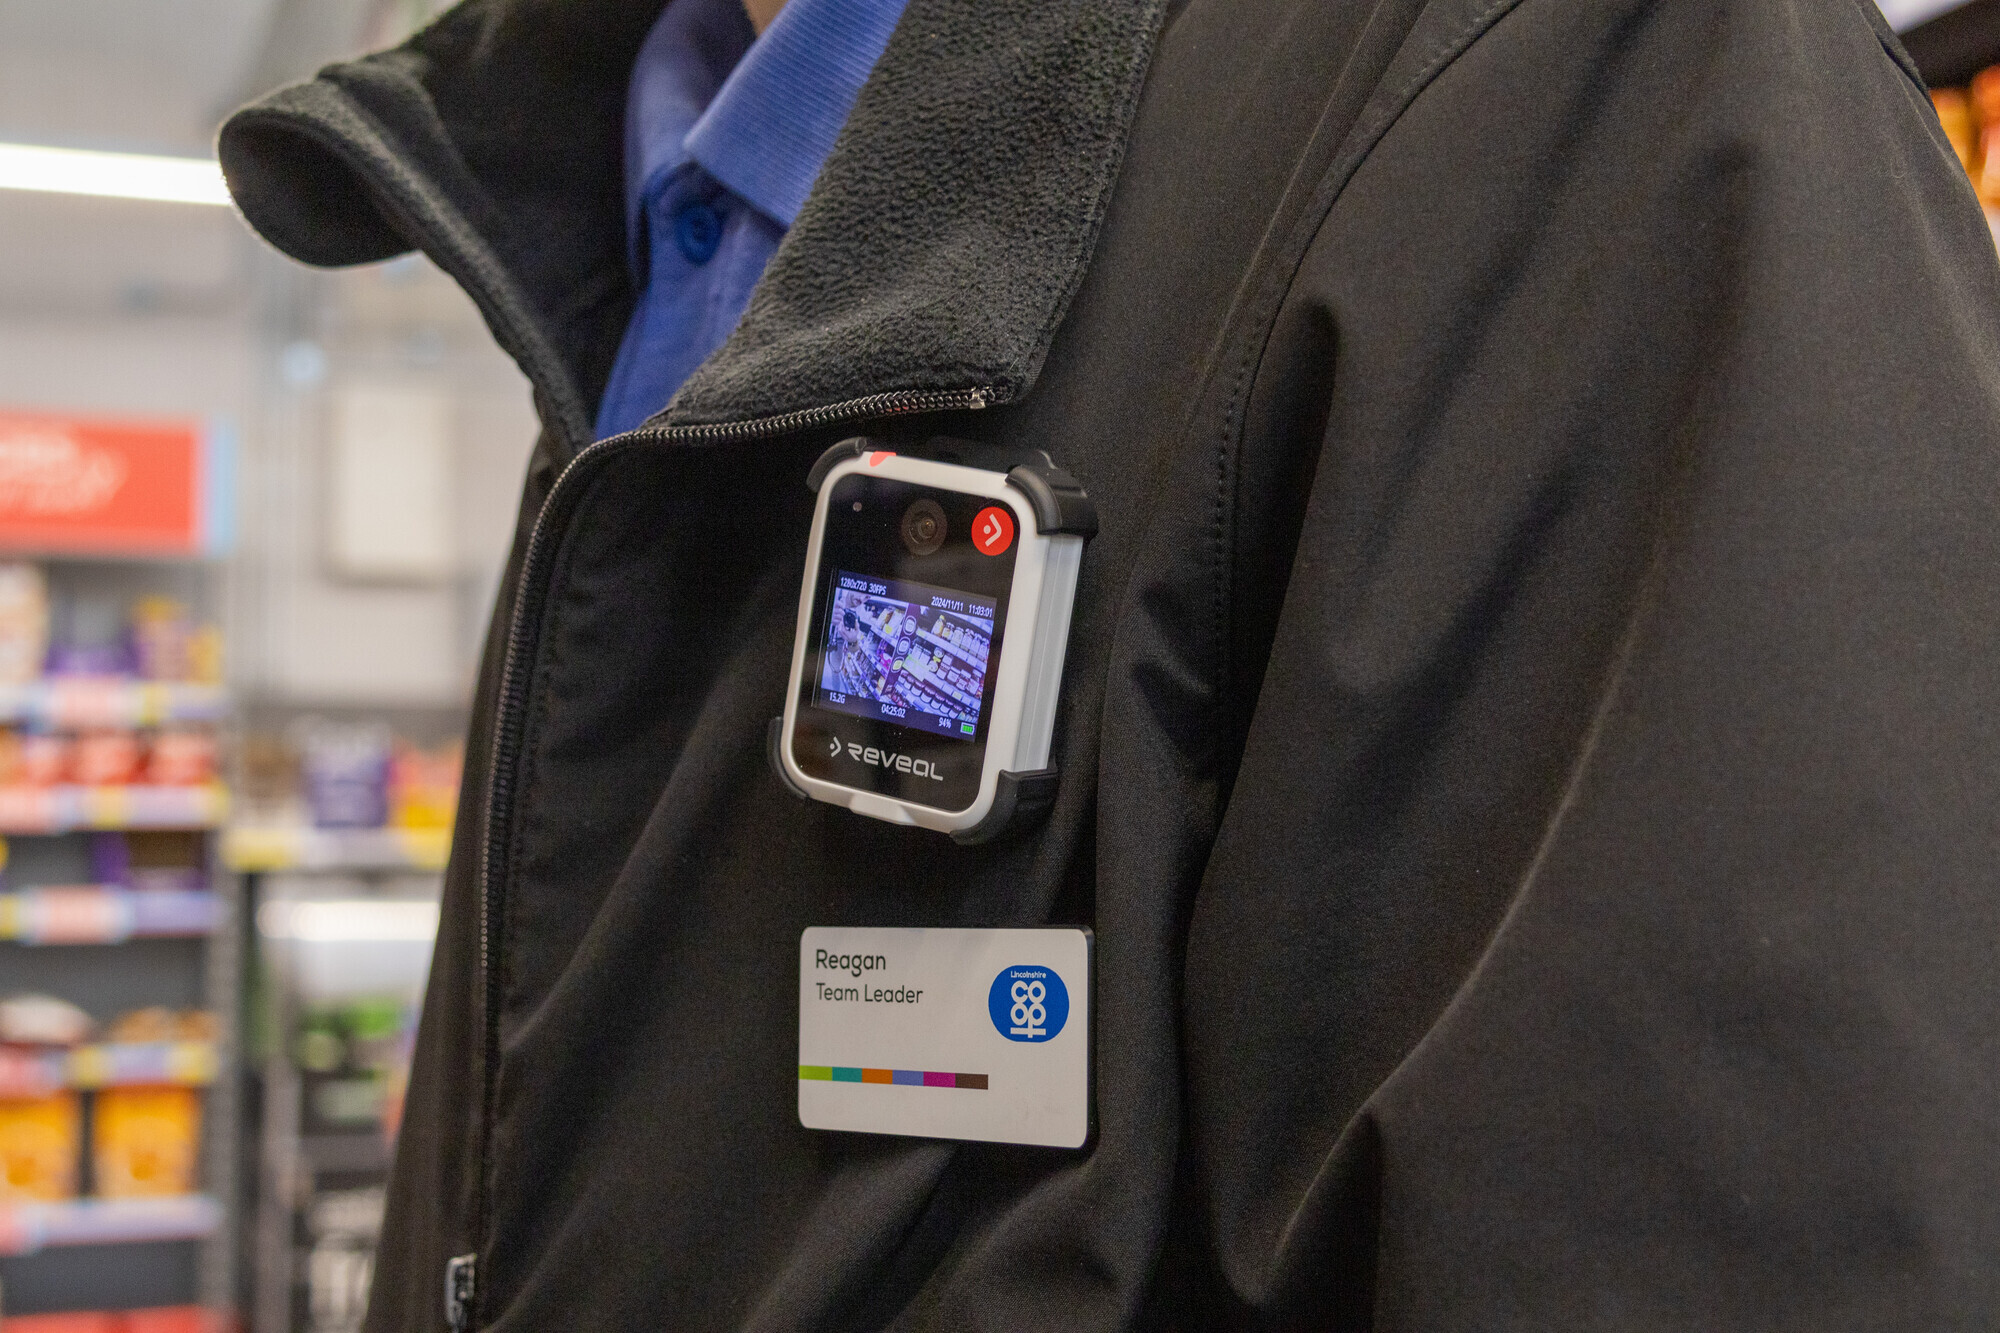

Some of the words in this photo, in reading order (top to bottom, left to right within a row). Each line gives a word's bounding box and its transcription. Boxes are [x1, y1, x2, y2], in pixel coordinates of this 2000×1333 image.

[840, 577, 867, 592] 1280x720
[868, 582, 887, 595] 30FPS
[931, 595, 964, 612] 2024/11/11
[829, 692, 846, 705] 15.2G
[881, 704, 906, 719] 04:25:02
[938, 717, 952, 729] 94%
[815, 949, 887, 978] Reagan
[1010, 970, 1047, 979] Lincolnshire
[816, 982, 859, 1002] Team
[864, 984, 924, 1004] Leader
